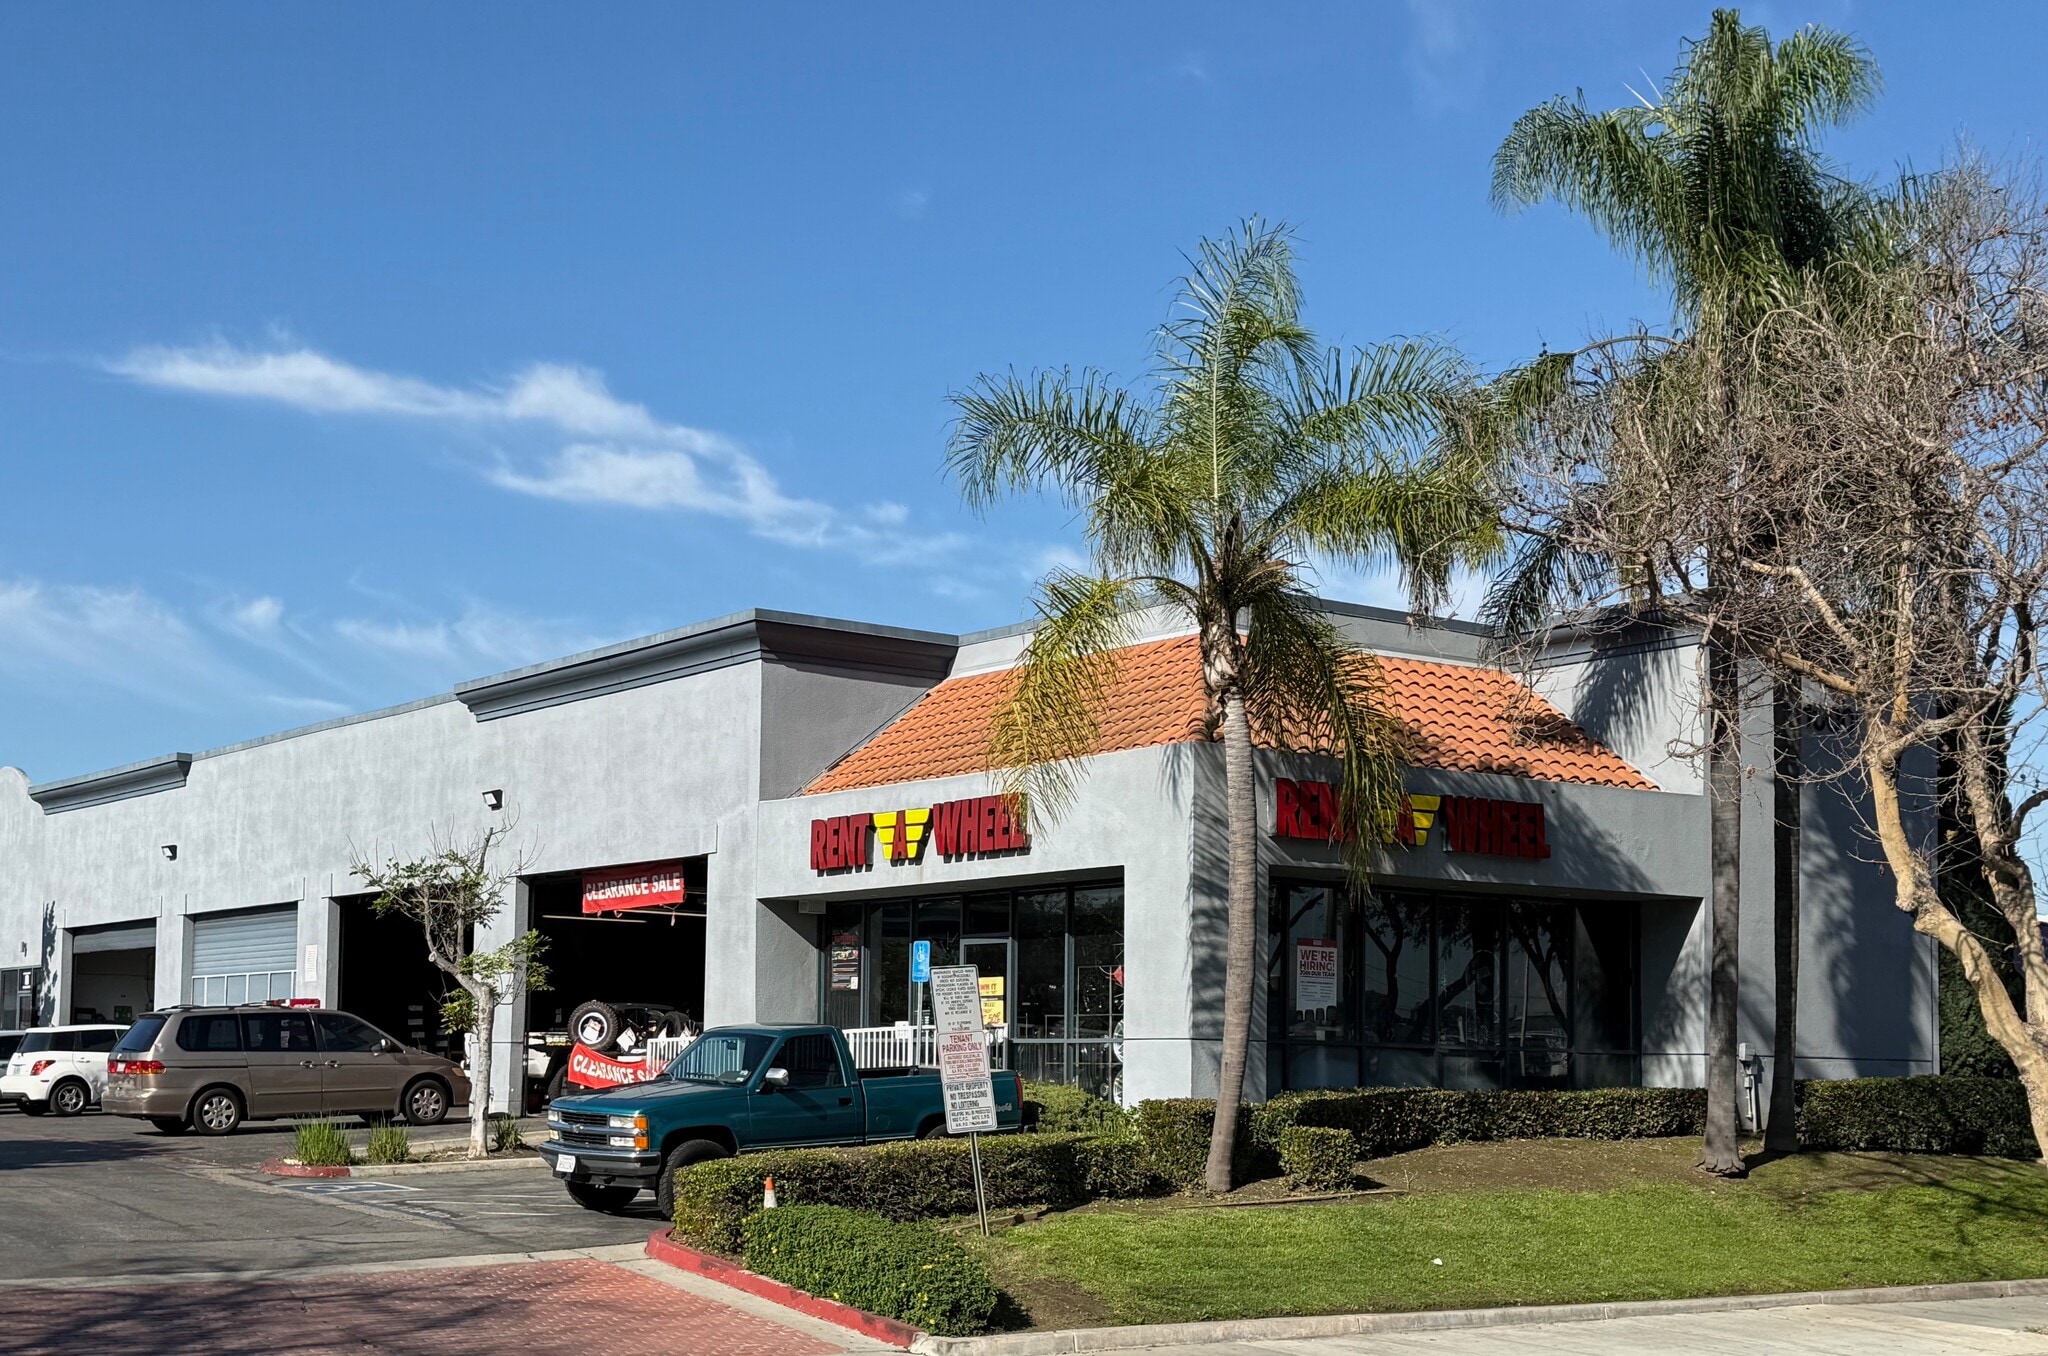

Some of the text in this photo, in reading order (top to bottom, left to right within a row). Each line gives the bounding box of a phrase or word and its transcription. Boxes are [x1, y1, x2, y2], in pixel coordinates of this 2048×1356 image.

[811, 813, 870, 870] RENT
[933, 793, 1027, 855] WHEEL
[1446, 795, 1551, 858] WHEEL
[585, 872, 681, 901] CLEARANCE SALE
[1300, 950, 1335, 962] WE'RE
[1300, 960, 1335, 971] HIRING!
[950, 1034, 973, 1043] TENANT
[942, 1042, 983, 1053] PARKING ONLY
[573, 1054, 634, 1084] CLEARANCE
[946, 1083, 965, 1091] PRIVATE
[957, 1090, 987, 1099] TRESPASSING
[958, 1100, 979, 1109] LOITERING
